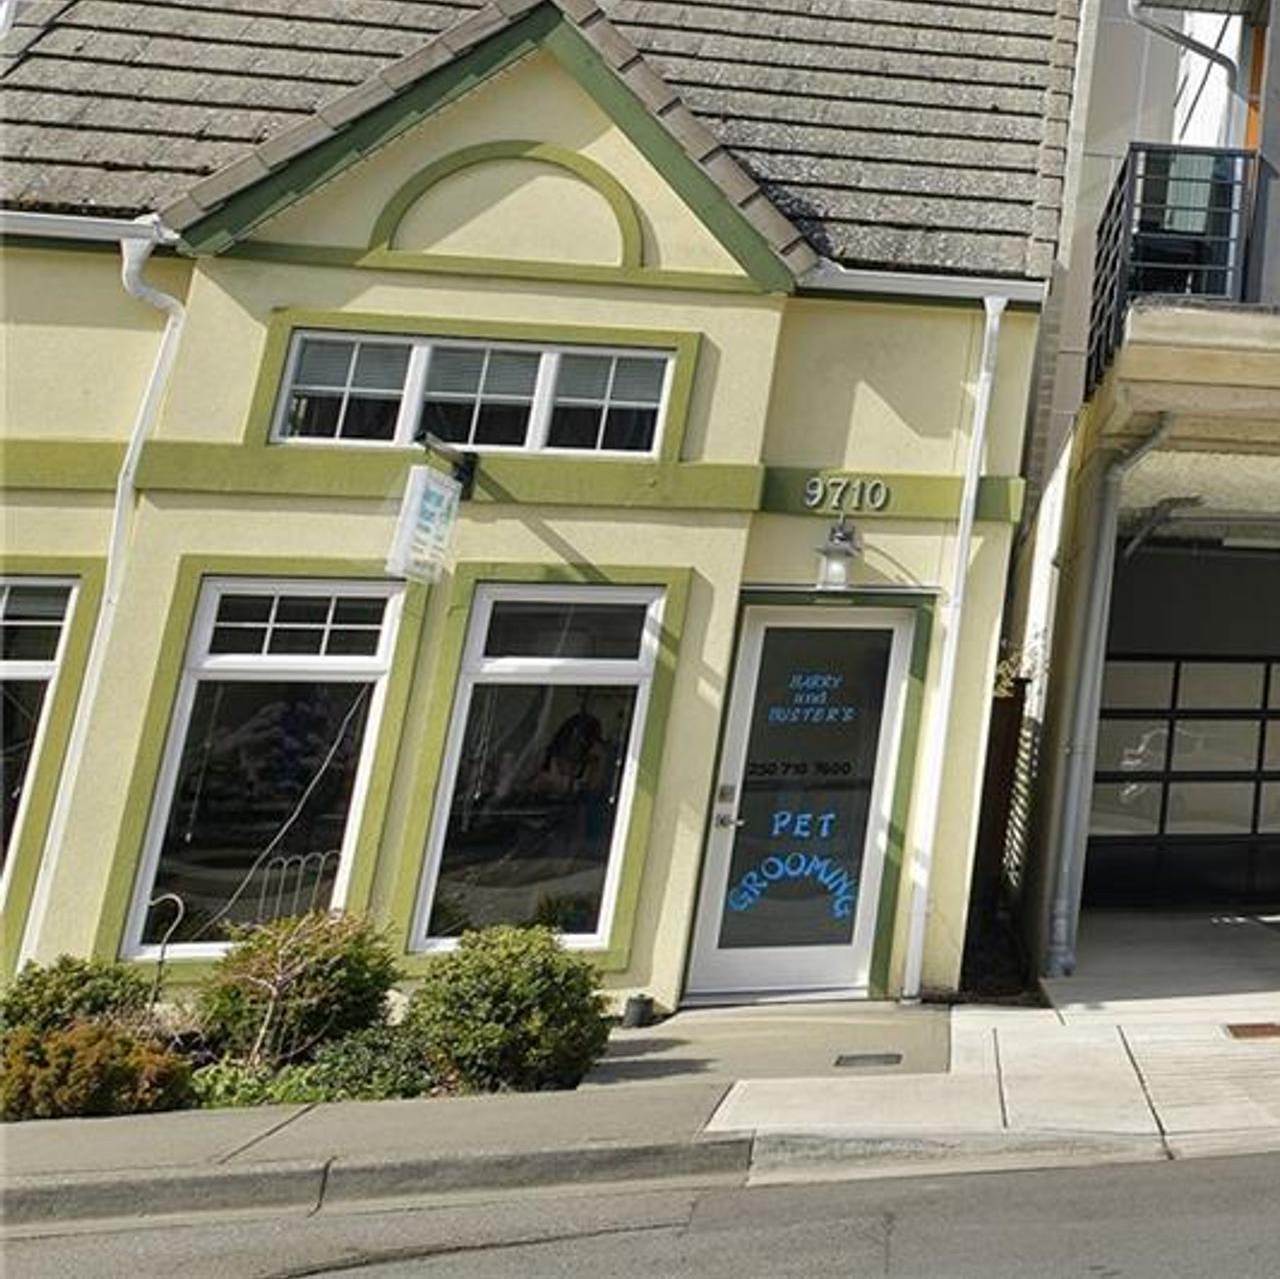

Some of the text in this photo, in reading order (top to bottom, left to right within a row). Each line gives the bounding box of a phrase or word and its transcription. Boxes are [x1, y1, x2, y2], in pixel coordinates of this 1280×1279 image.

[805, 477, 888, 509] 9710
[772, 810, 836, 837] PET
[728, 852, 856, 918] GROOMING
